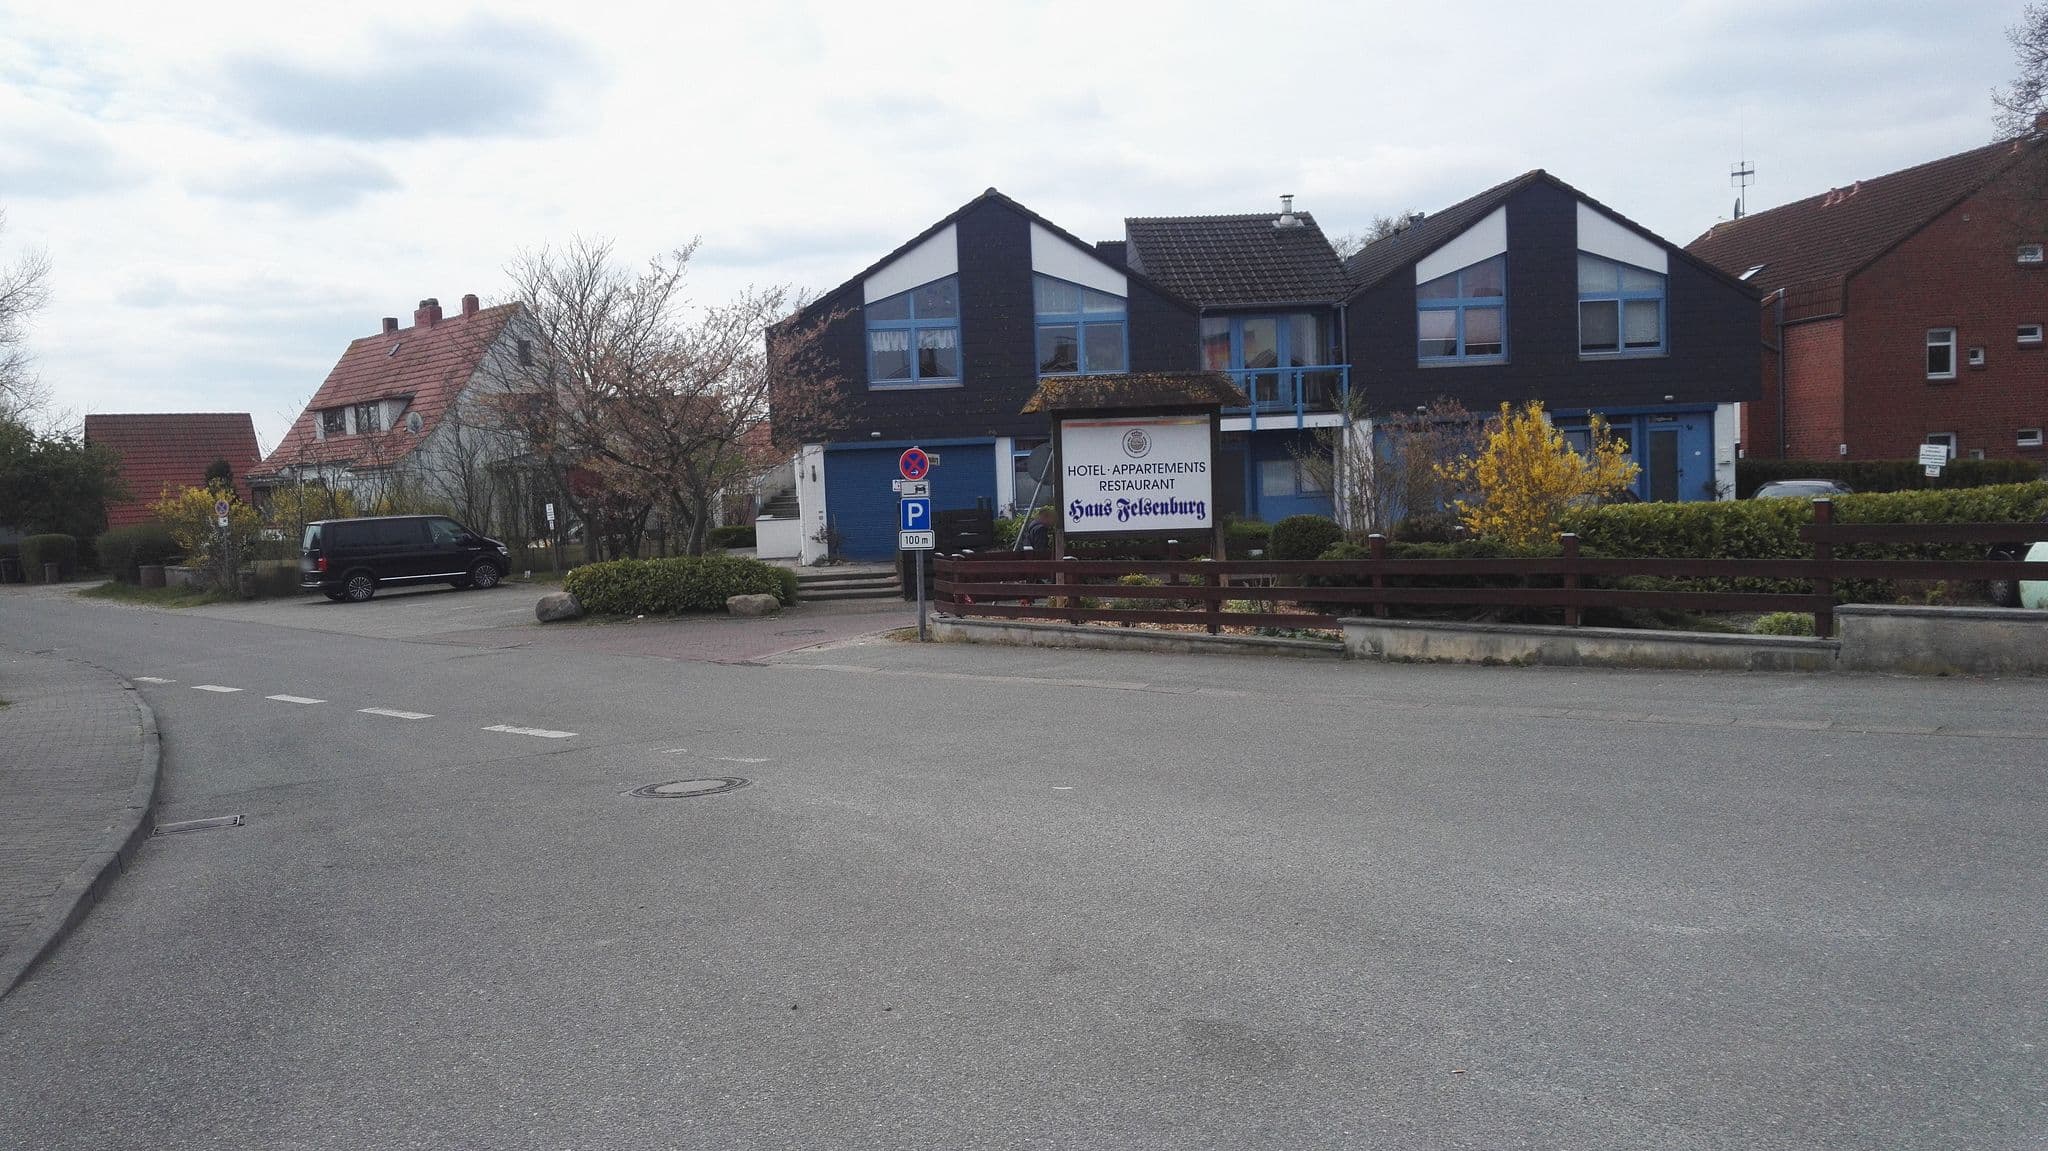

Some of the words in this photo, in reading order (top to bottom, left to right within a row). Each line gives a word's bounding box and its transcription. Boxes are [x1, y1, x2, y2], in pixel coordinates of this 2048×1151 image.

[1112, 462, 1206, 475] APPARTEMENTS
[1099, 479, 1175, 491] RESTAURANT
[908, 503, 923, 526] P
[1069, 498, 1112, 523] Haus
[1116, 496, 1206, 522] Felsenburg
[905, 536, 920, 545] 100
